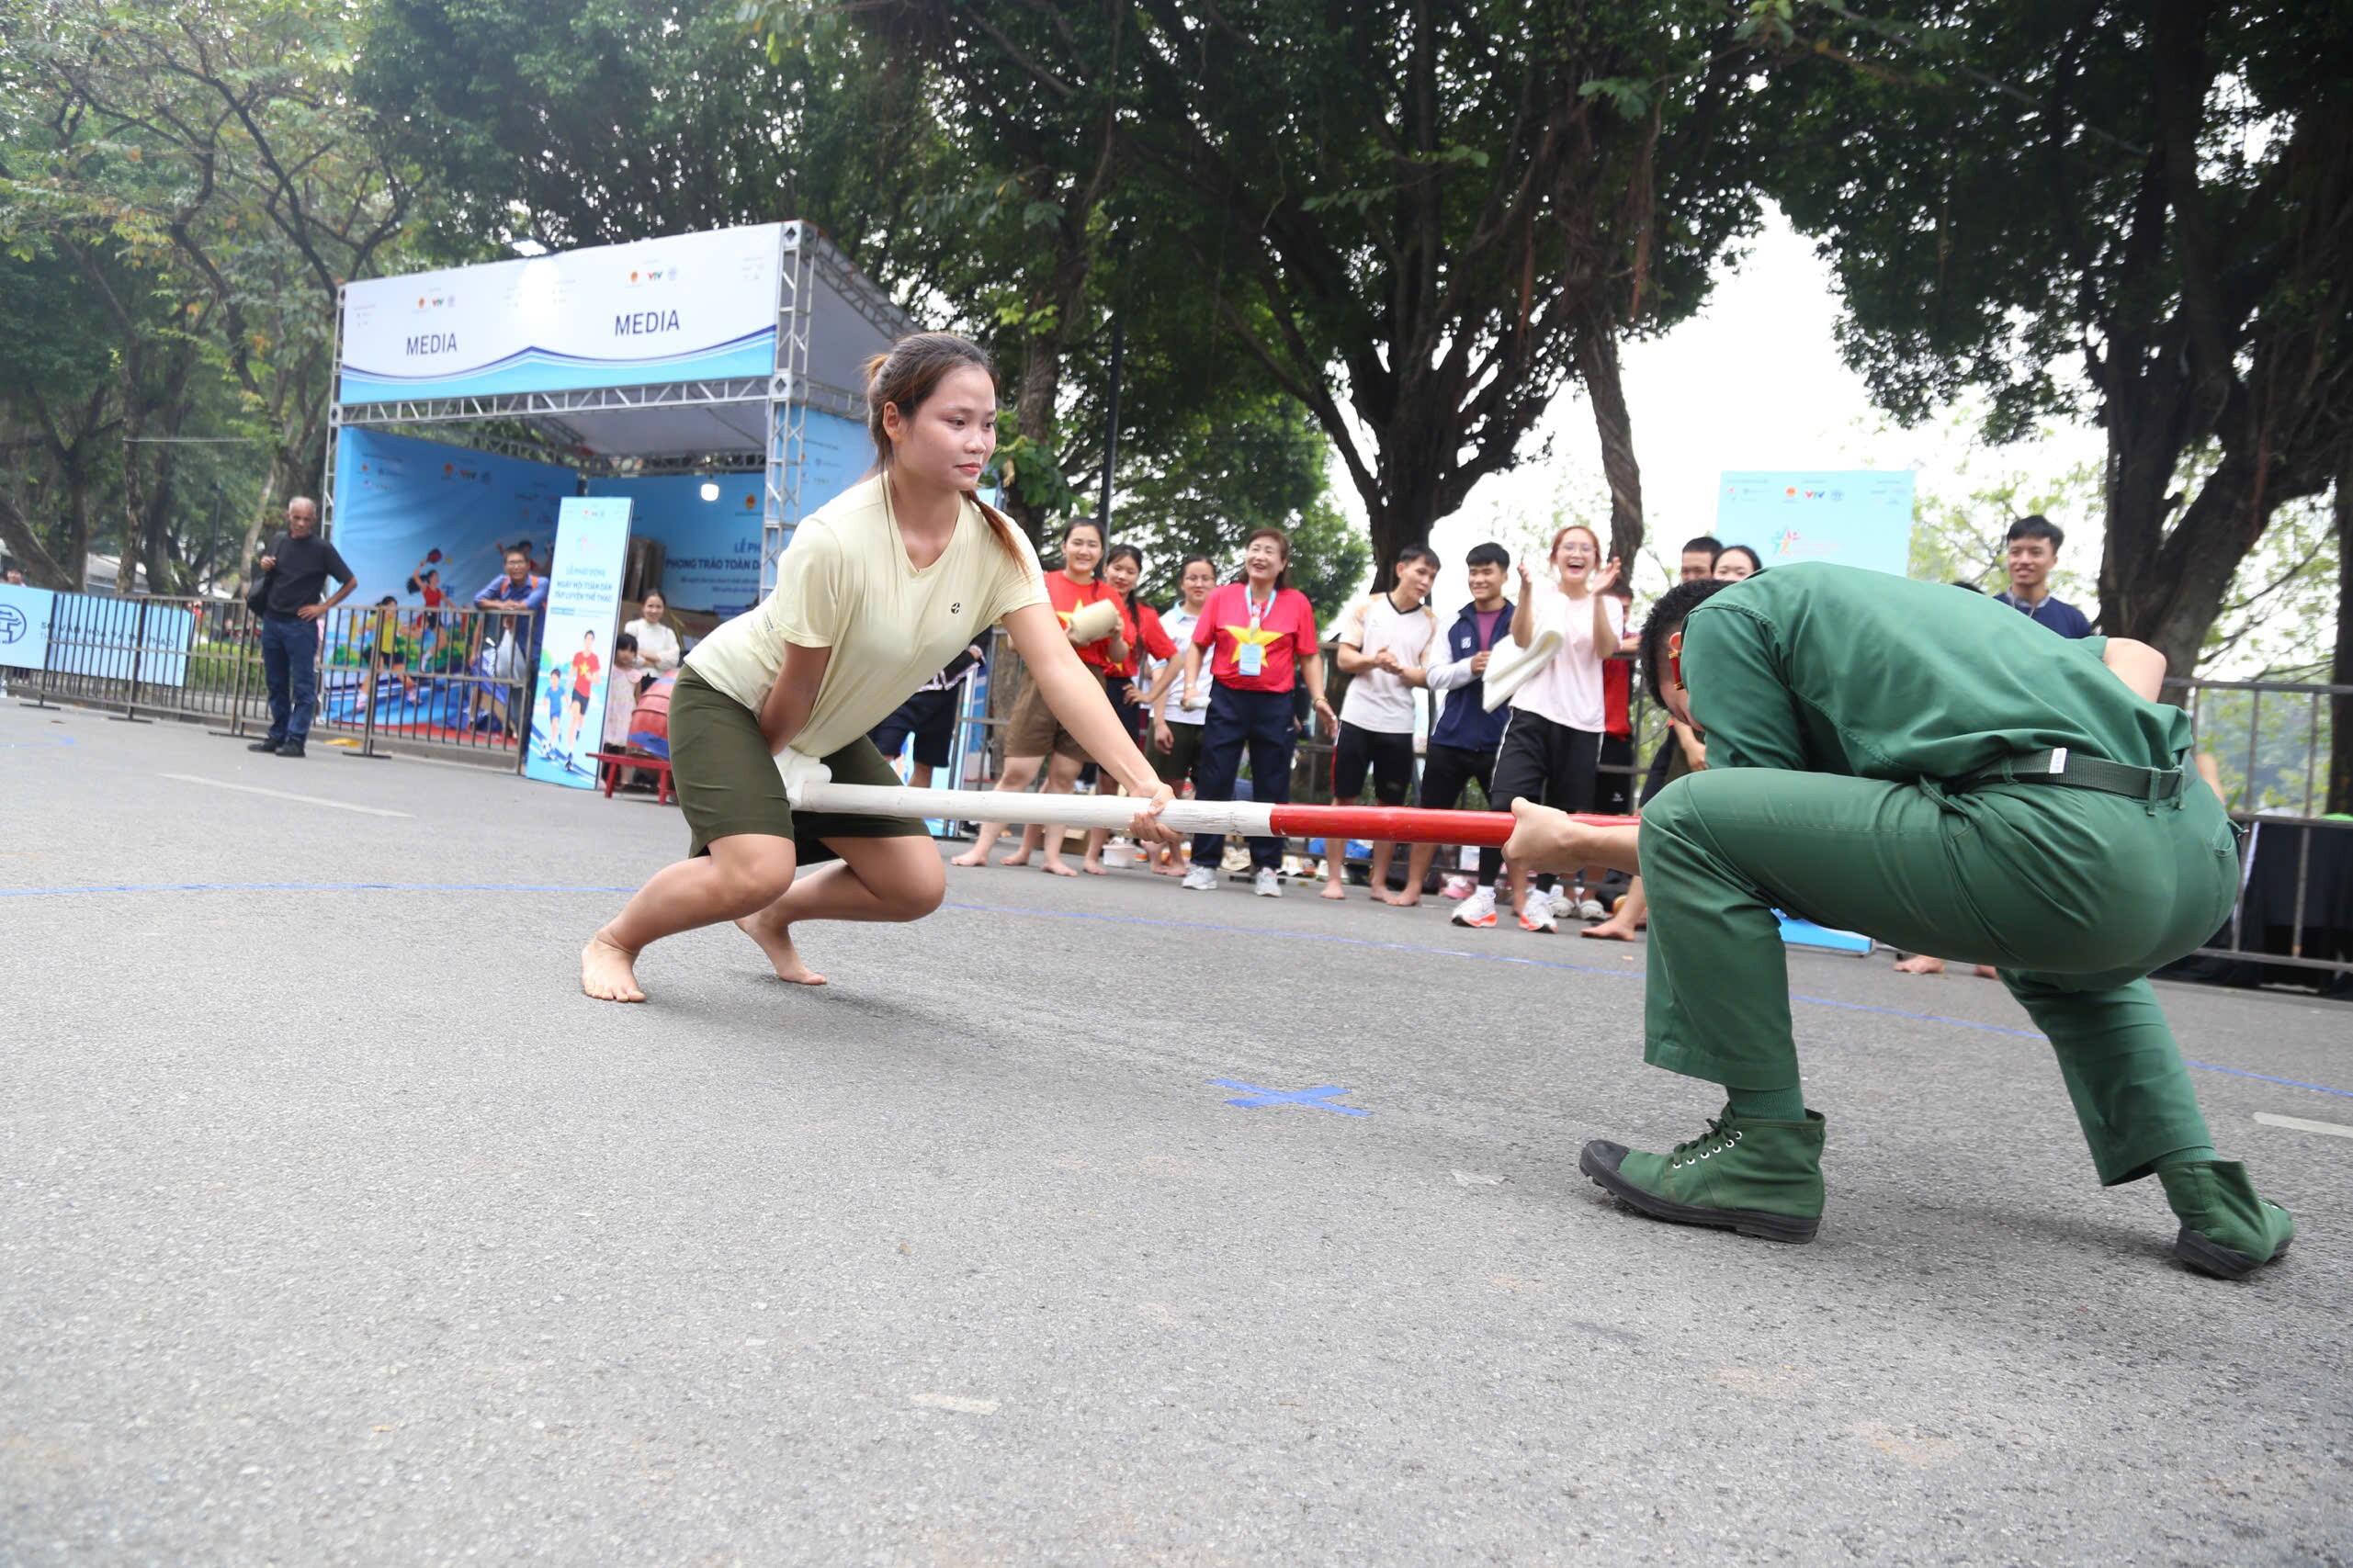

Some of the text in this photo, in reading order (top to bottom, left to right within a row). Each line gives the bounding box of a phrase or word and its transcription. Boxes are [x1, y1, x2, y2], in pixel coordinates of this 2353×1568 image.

[615, 309, 680, 336] MEDIA
[406, 333, 458, 356] MEDIA
[1804, 491, 1825, 499] VTV
[666, 558, 696, 570] PHONG
